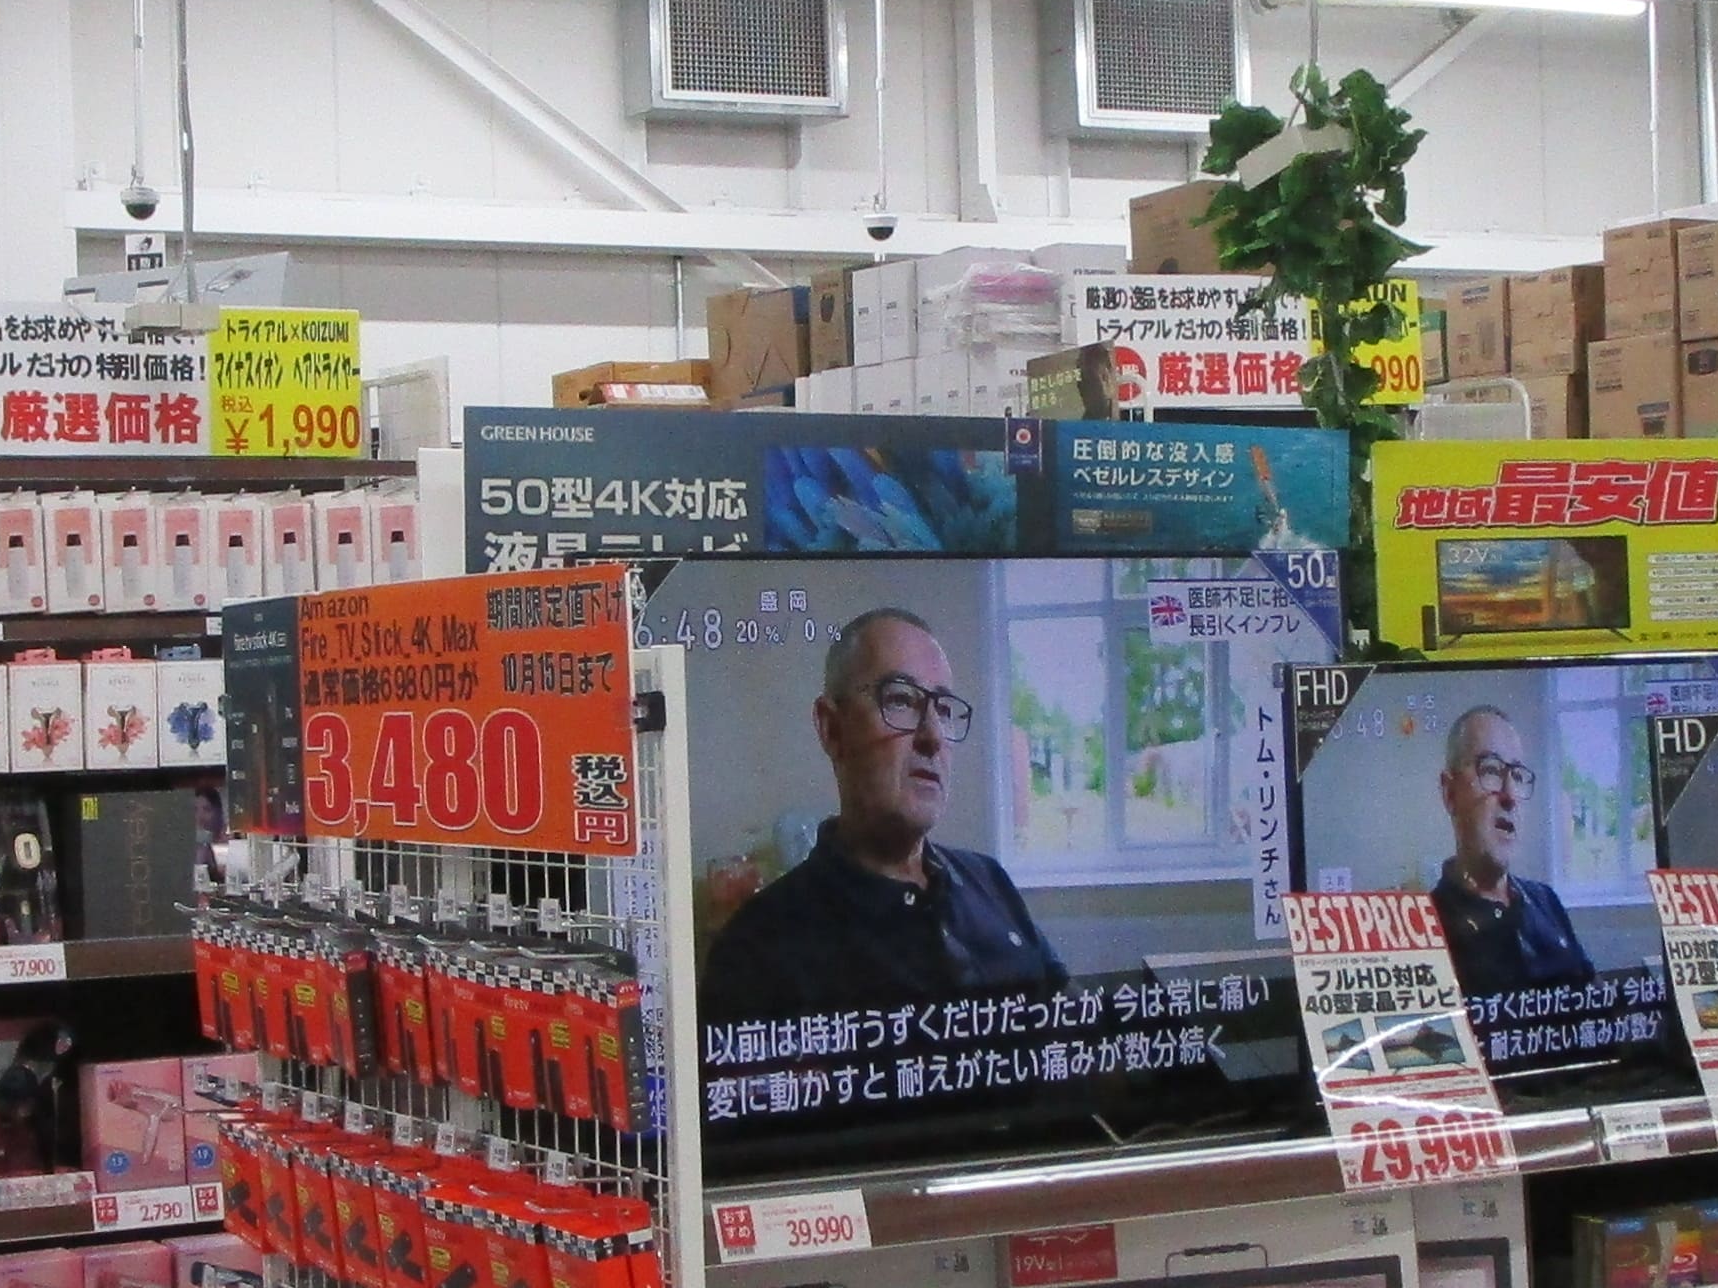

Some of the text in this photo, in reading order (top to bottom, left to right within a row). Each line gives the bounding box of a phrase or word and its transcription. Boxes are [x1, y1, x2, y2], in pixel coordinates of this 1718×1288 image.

[215, 352, 361, 390] マイナスイオン ヘアドライヤー
[1157, 351, 1305, 395] 厳選価格
[1, 390, 201, 444] 厳選価格
[221, 394, 254, 413] 税込
[481, 425, 594, 442] GREEN HOUSE
[1072, 439, 1235, 465] 圧倒的な没入感
[1072, 466, 1235, 488] ベゼルレスデザイン
[480, 477, 748, 520] 50型4K対応
[300, 595, 369, 619] Amazon
[1188, 587, 1296, 609] 医師不足に拍
[1188, 614, 1300, 636] 長引くインフレ
[1296, 669, 1348, 706] FHD
[1657, 718, 1706, 754] HD
[306, 708, 544, 836] 3,480
[10, 958, 55, 978] 37,900
[1311, 964, 1437, 992] フルHD対応
[1305, 987, 1457, 1015] 40型液晶テレビ
[1463, 978, 1620, 1024] うずくだけだったが
[705, 974, 1270, 1066] 以前は時折うずくだけだったが 今は常に痛い
[707, 1024, 1228, 1122] 変に動かすと 耐えがたい痛みが数分続く
[141, 1201, 183, 1222] 2,790
[787, 1214, 854, 1248] 39,990
